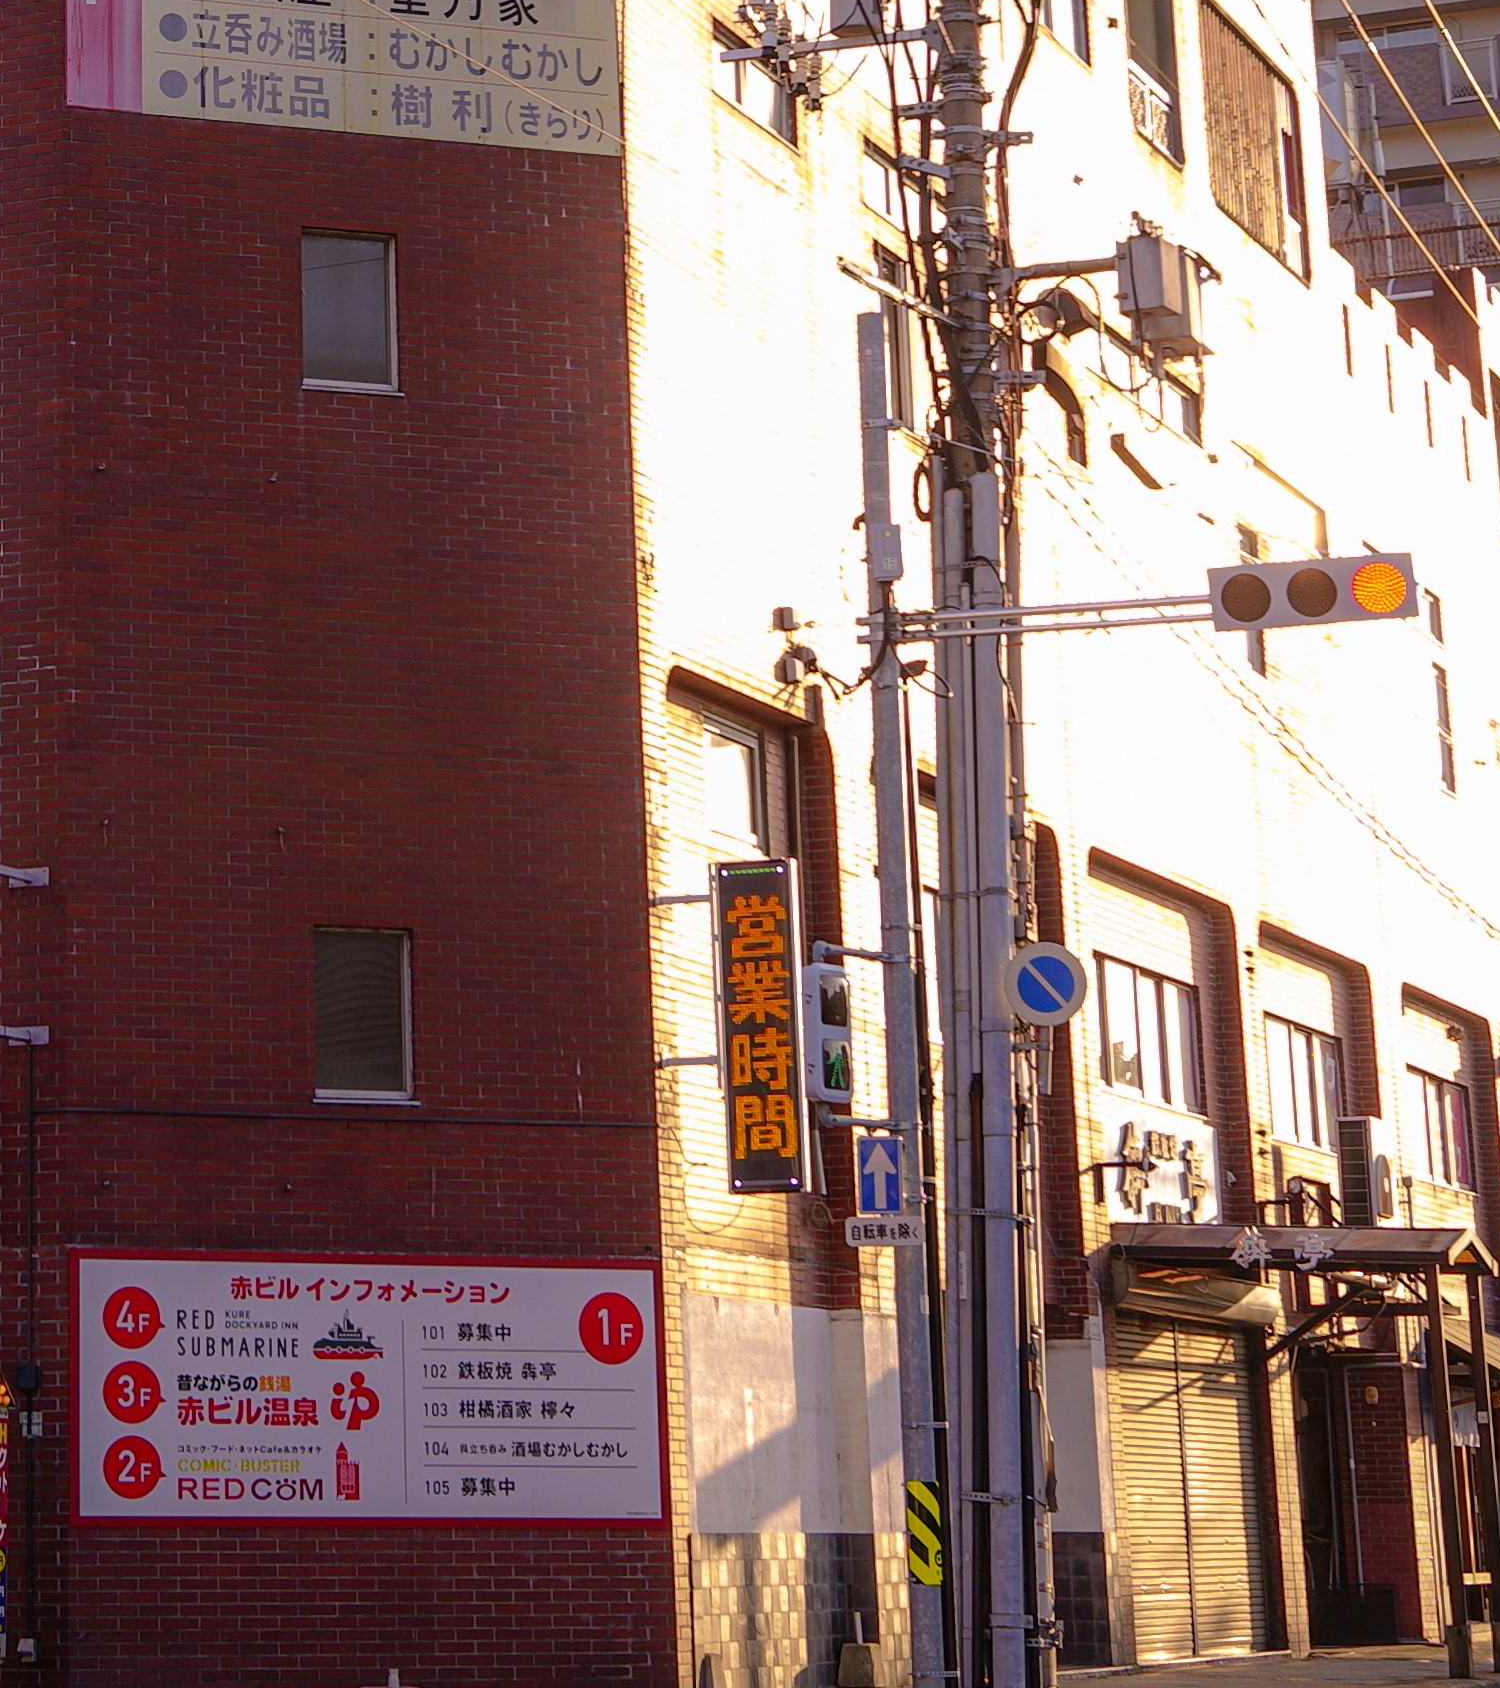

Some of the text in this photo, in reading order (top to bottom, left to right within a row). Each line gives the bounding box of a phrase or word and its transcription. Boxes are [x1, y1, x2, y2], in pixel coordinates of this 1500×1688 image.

[191, 8, 604, 87] 立呑み酒場 むかしむかし
[192, 65, 331, 120] 化粧品
[725, 894, 799, 1160] 営業時間
[850, 1224, 919, 1241] 自転車を除く
[116, 1299, 151, 1334] 4F
[177, 1309, 214, 1329] RED
[225, 1310, 250, 1319] KURE
[225, 1321, 299, 1330] DOCKYARD INN
[422, 1322, 512, 1342] 101 募集中
[597, 1308, 634, 1346] 1F
[177, 1337, 299, 1358] SUBMARINE
[423, 1364, 447, 1379] 102
[458, 1362, 513, 1380] 鉄板焼
[117, 1375, 152, 1407] 3F
[177, 1375, 291, 1392] 昔ながらの銭湯
[177, 1396, 319, 1426] 赤ビル温泉
[423, 1403, 448, 1417] 103
[423, 1441, 449, 1456] 104
[511, 1441, 629, 1458] 酒場むかしむかし
[117, 1449, 152, 1483] 2F
[178, 1459, 300, 1472] COMIC BUSTER
[425, 1477, 516, 1496] 105 募集中
